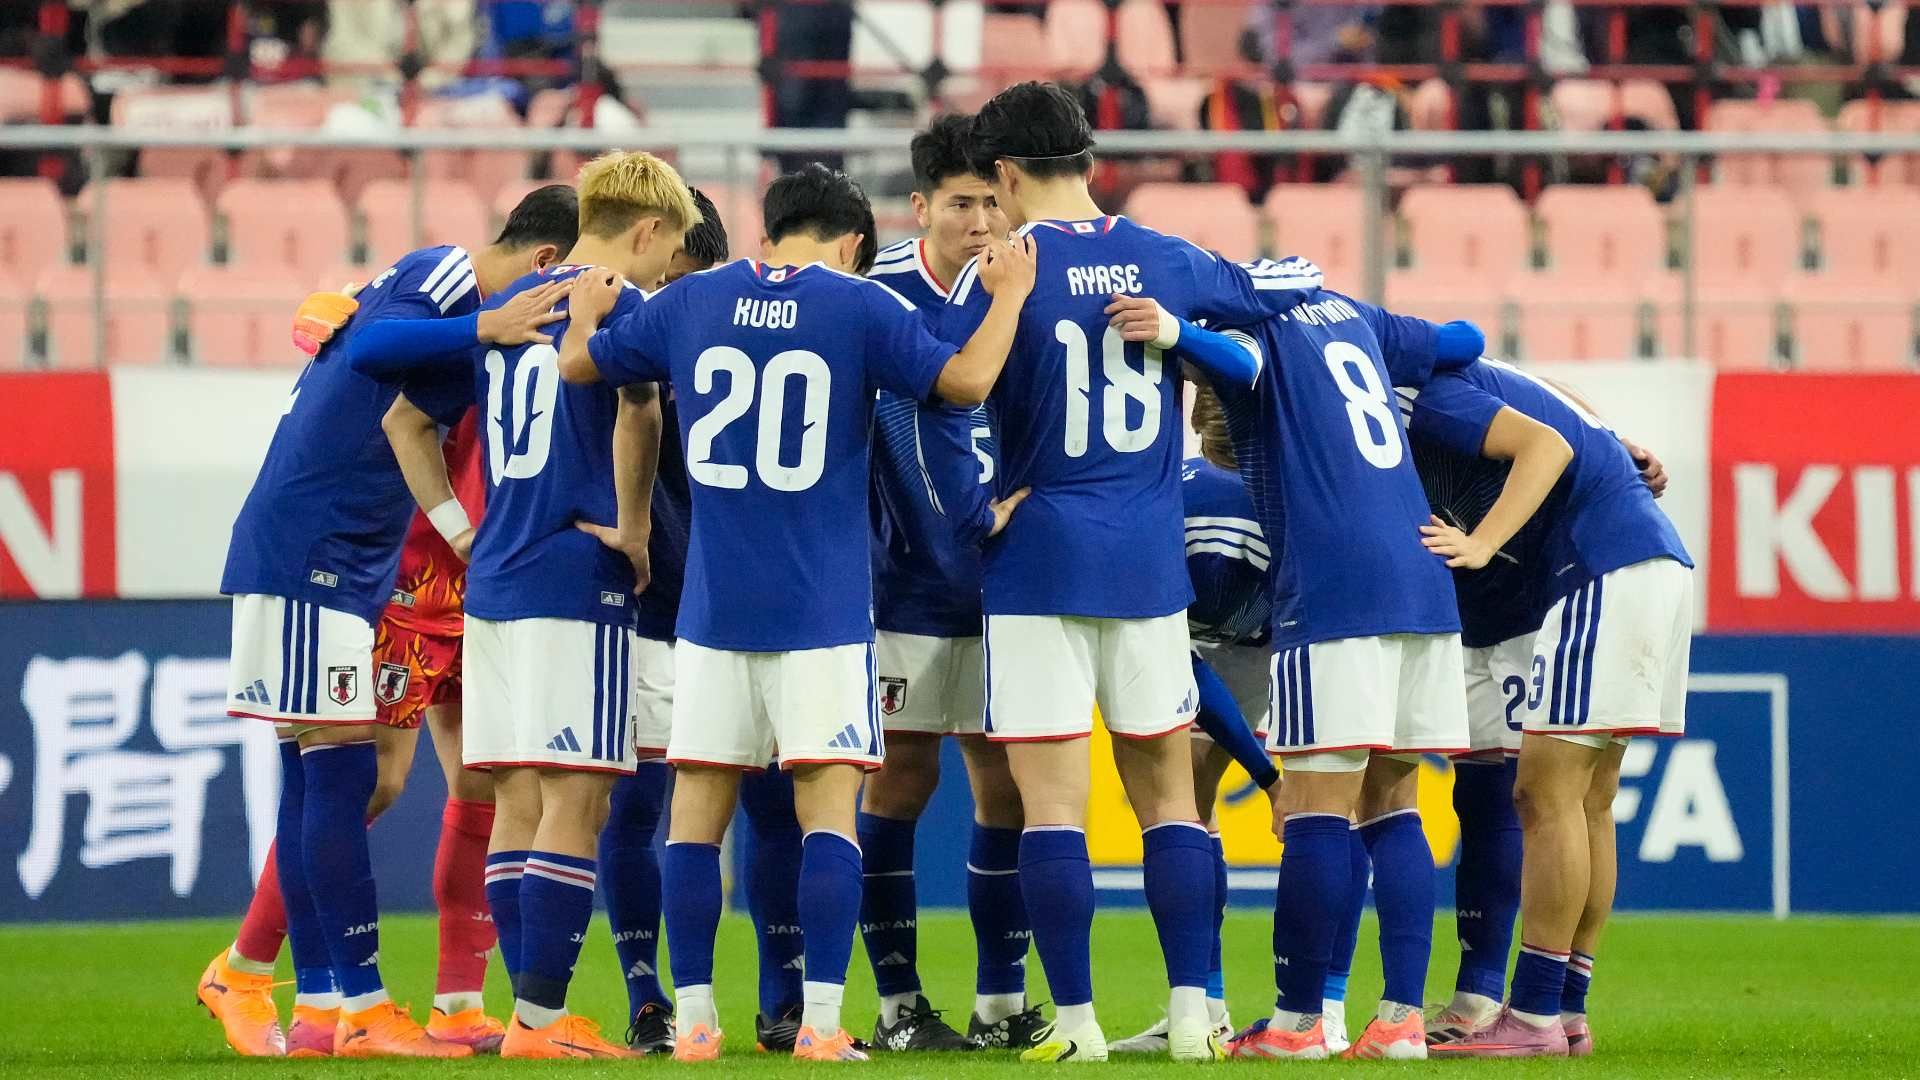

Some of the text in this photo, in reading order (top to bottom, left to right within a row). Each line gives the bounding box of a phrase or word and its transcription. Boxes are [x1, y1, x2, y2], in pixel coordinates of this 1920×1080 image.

[733, 297, 798, 330] KUBO
[1066, 263, 1143, 296] AYASE
[485, 343, 560, 488] 10
[687, 345, 831, 492] 20
[1054, 319, 1162, 458] 18
[1324, 341, 1403, 470] 8
[970, 427, 994, 485] 5
[1732, 461, 1920, 603] KI
[343, 922, 380, 937] JAP
[767, 925, 804, 935] JAP
